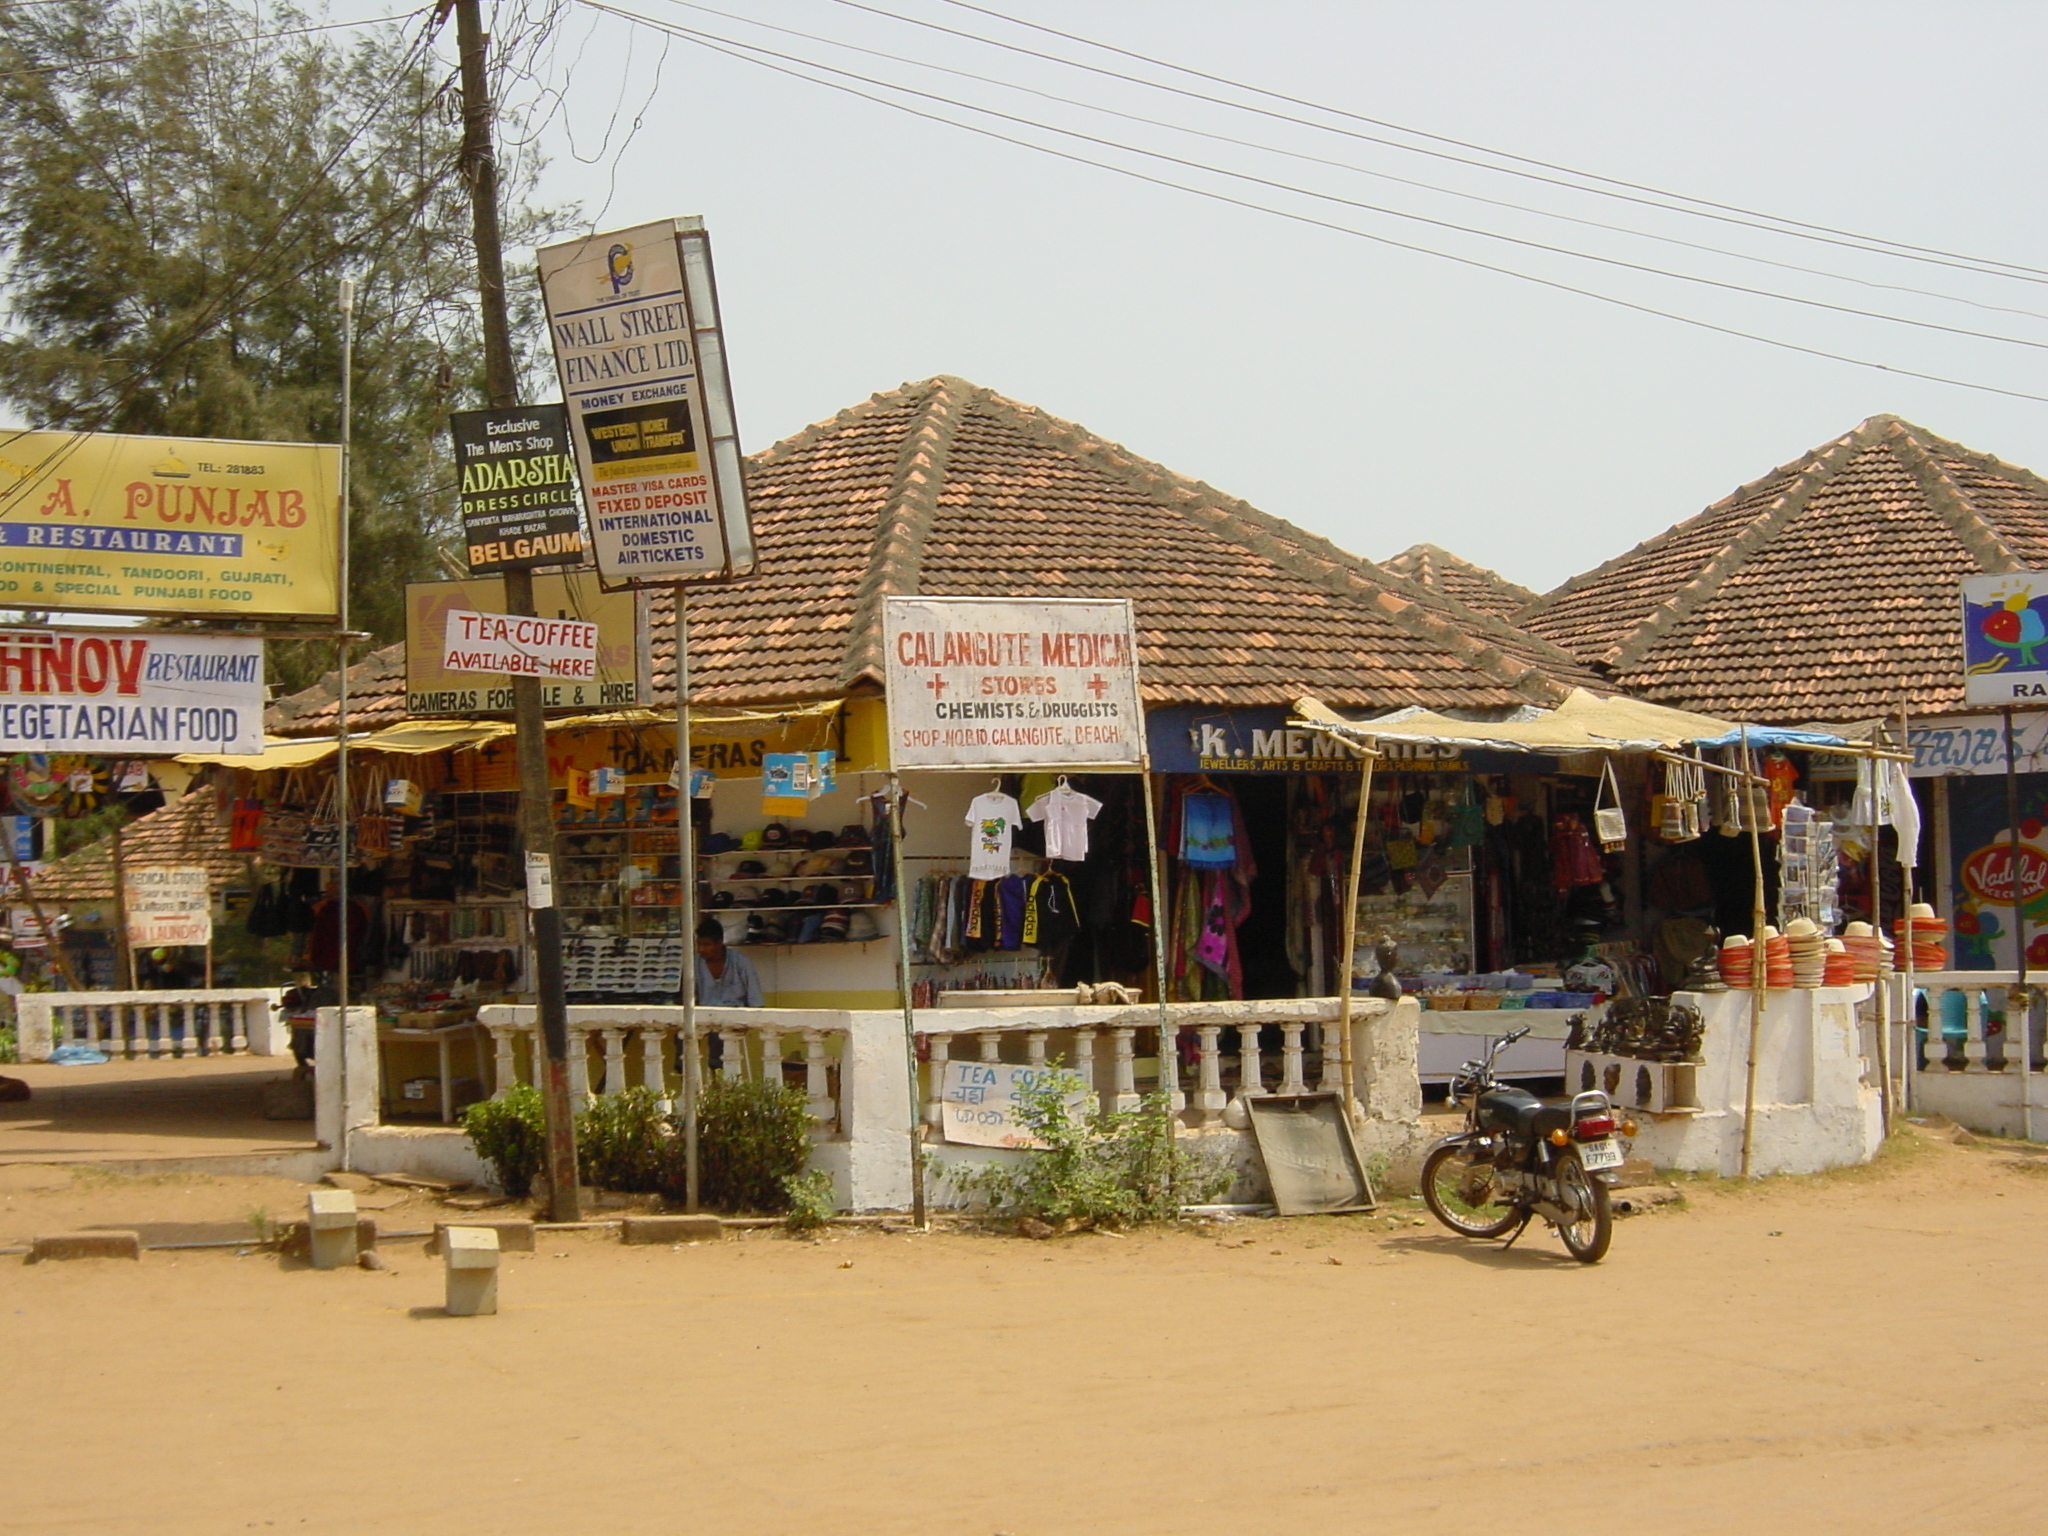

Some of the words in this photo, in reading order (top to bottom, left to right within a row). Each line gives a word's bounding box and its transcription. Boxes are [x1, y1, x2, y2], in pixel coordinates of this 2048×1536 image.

[556, 316, 614, 349] WALL
[620, 302, 687, 338] STREET
[566, 345, 650, 384] FINANCE
[656, 339, 693, 370] LTD.
[581, 393, 625, 409] MONEY
[632, 383, 687, 400] EXCHANGE
[486, 419, 540, 435] Exclusive
[465, 443, 484, 457] The
[489, 440, 522, 455] Men's
[527, 436, 553, 451] Shop
[197, 462, 221, 474] TEL:
[226, 464, 265, 475] 281883
[461, 454, 574, 494] ADARSHA
[592, 483, 638, 497] MASTER
[642, 480, 664, 491] VISA
[668, 475, 707, 489] CARDS
[40, 478, 90, 517] A.
[123, 481, 307, 528] PUNJAB
[464, 495, 518, 514] DRESS
[523, 490, 577, 507] CIRCLE
[598, 497, 641, 514] FIXED
[645, 491, 708, 508] DEPOSIT
[524, 523, 547, 533] BAZAR
[599, 509, 713, 532] INTERNATIONAL
[27, 526, 236, 555] RESTAURANT
[469, 531, 581, 566] BELGAUM
[623, 529, 694, 547] DOMESTIC
[0, 561, 111, 578] ONTINENTAL,
[33, 582, 44, 592] &
[54, 582, 121, 596] SPECIAL
[134, 586, 203, 599] PUNJABI
[209, 588, 253, 601] FOOD
[898, 632, 1031, 667] CALANGUTE
[146, 652, 260, 683] RESTAURANT
[446, 651, 539, 673] AVAILABLE
[550, 658, 594, 676] HERE
[409, 690, 477, 712] CAMERAS
[487, 688, 514, 709] FOR
[573, 686, 585, 704] &
[600, 682, 634, 704] HIRE
[981, 676, 1057, 696] STORES
[1043, 702, 1118, 719] DRUGGISTS
[0, 704, 168, 741] EGETARIAN
[175, 707, 238, 742] FOOD
[1074, 726, 1119, 745] BEACH
[1262, 760, 1288, 771] ARTS
[1305, 760, 1344, 771] CRAFTS
[1025, 895, 1036, 936] adidas
[958, 1065, 996, 1085] TEA
